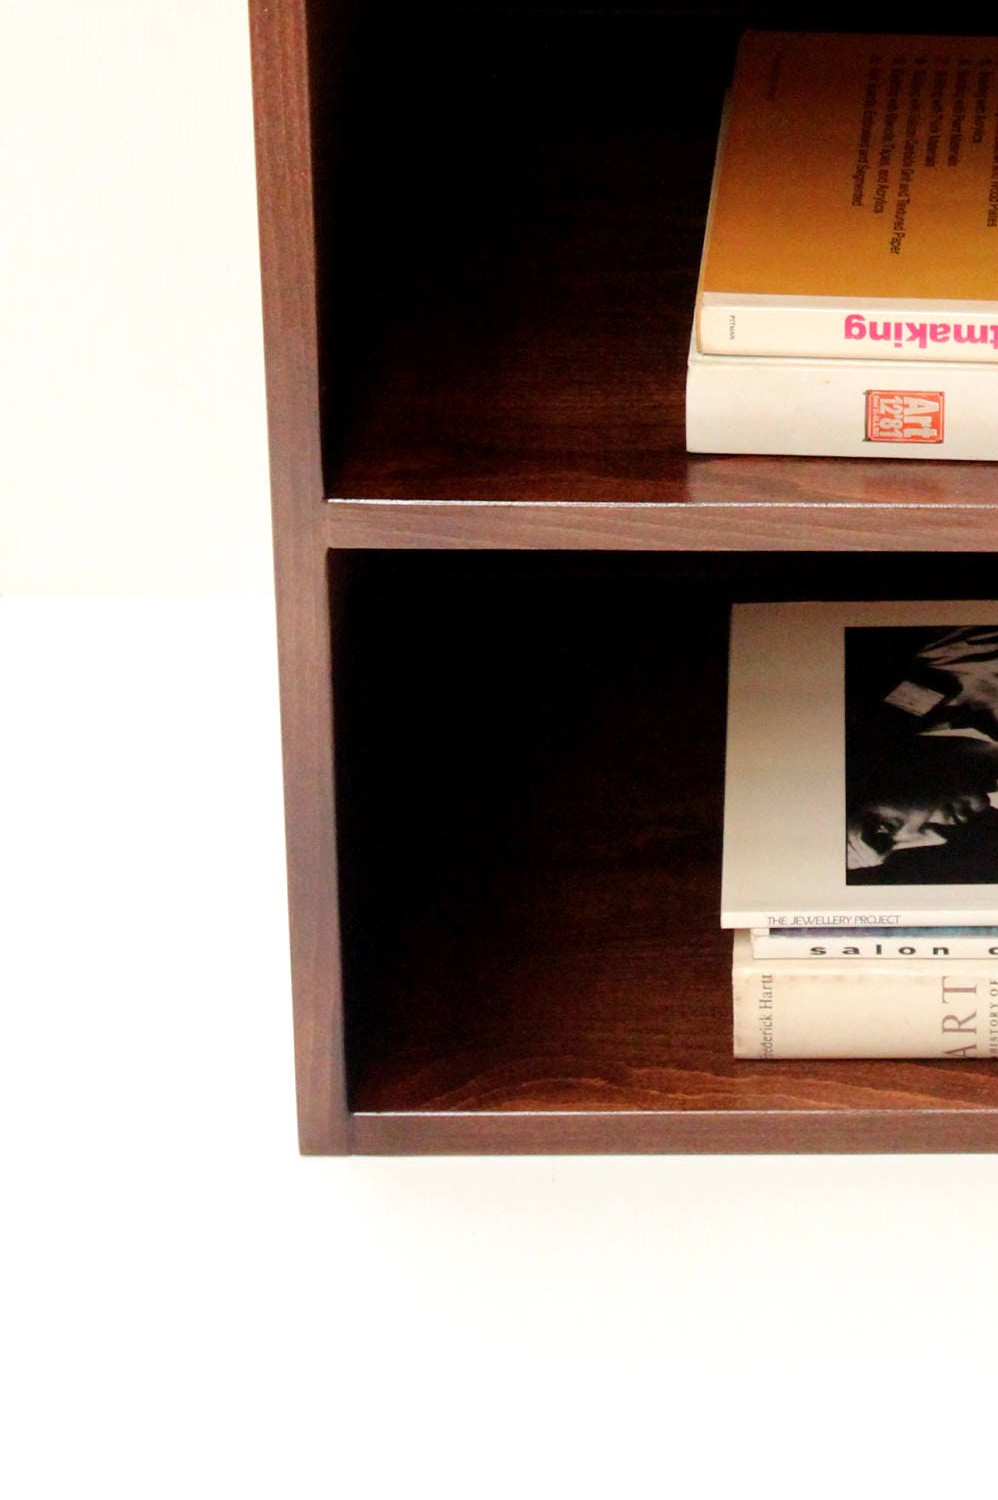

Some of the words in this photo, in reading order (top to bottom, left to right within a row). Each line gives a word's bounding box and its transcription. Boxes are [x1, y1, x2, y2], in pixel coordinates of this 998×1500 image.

[852, 165, 869, 205] Segmented
[901, 169, 913, 181] Grit
[873, 184, 890, 213] Acrylics
[898, 184, 910, 196] and
[893, 199, 910, 230] Textured
[890, 232, 905, 254] Paper
[903, 396, 940, 439] Art
[767, 916, 788, 926] THE
[790, 916, 852, 926] JEWELLERY
[854, 915, 901, 925] PROJECT
[810, 944, 950, 956] salon
[989, 979, 998, 998] OF
[942, 976, 977, 1057] ART
[989, 1002, 998, 1054] HISTORY
